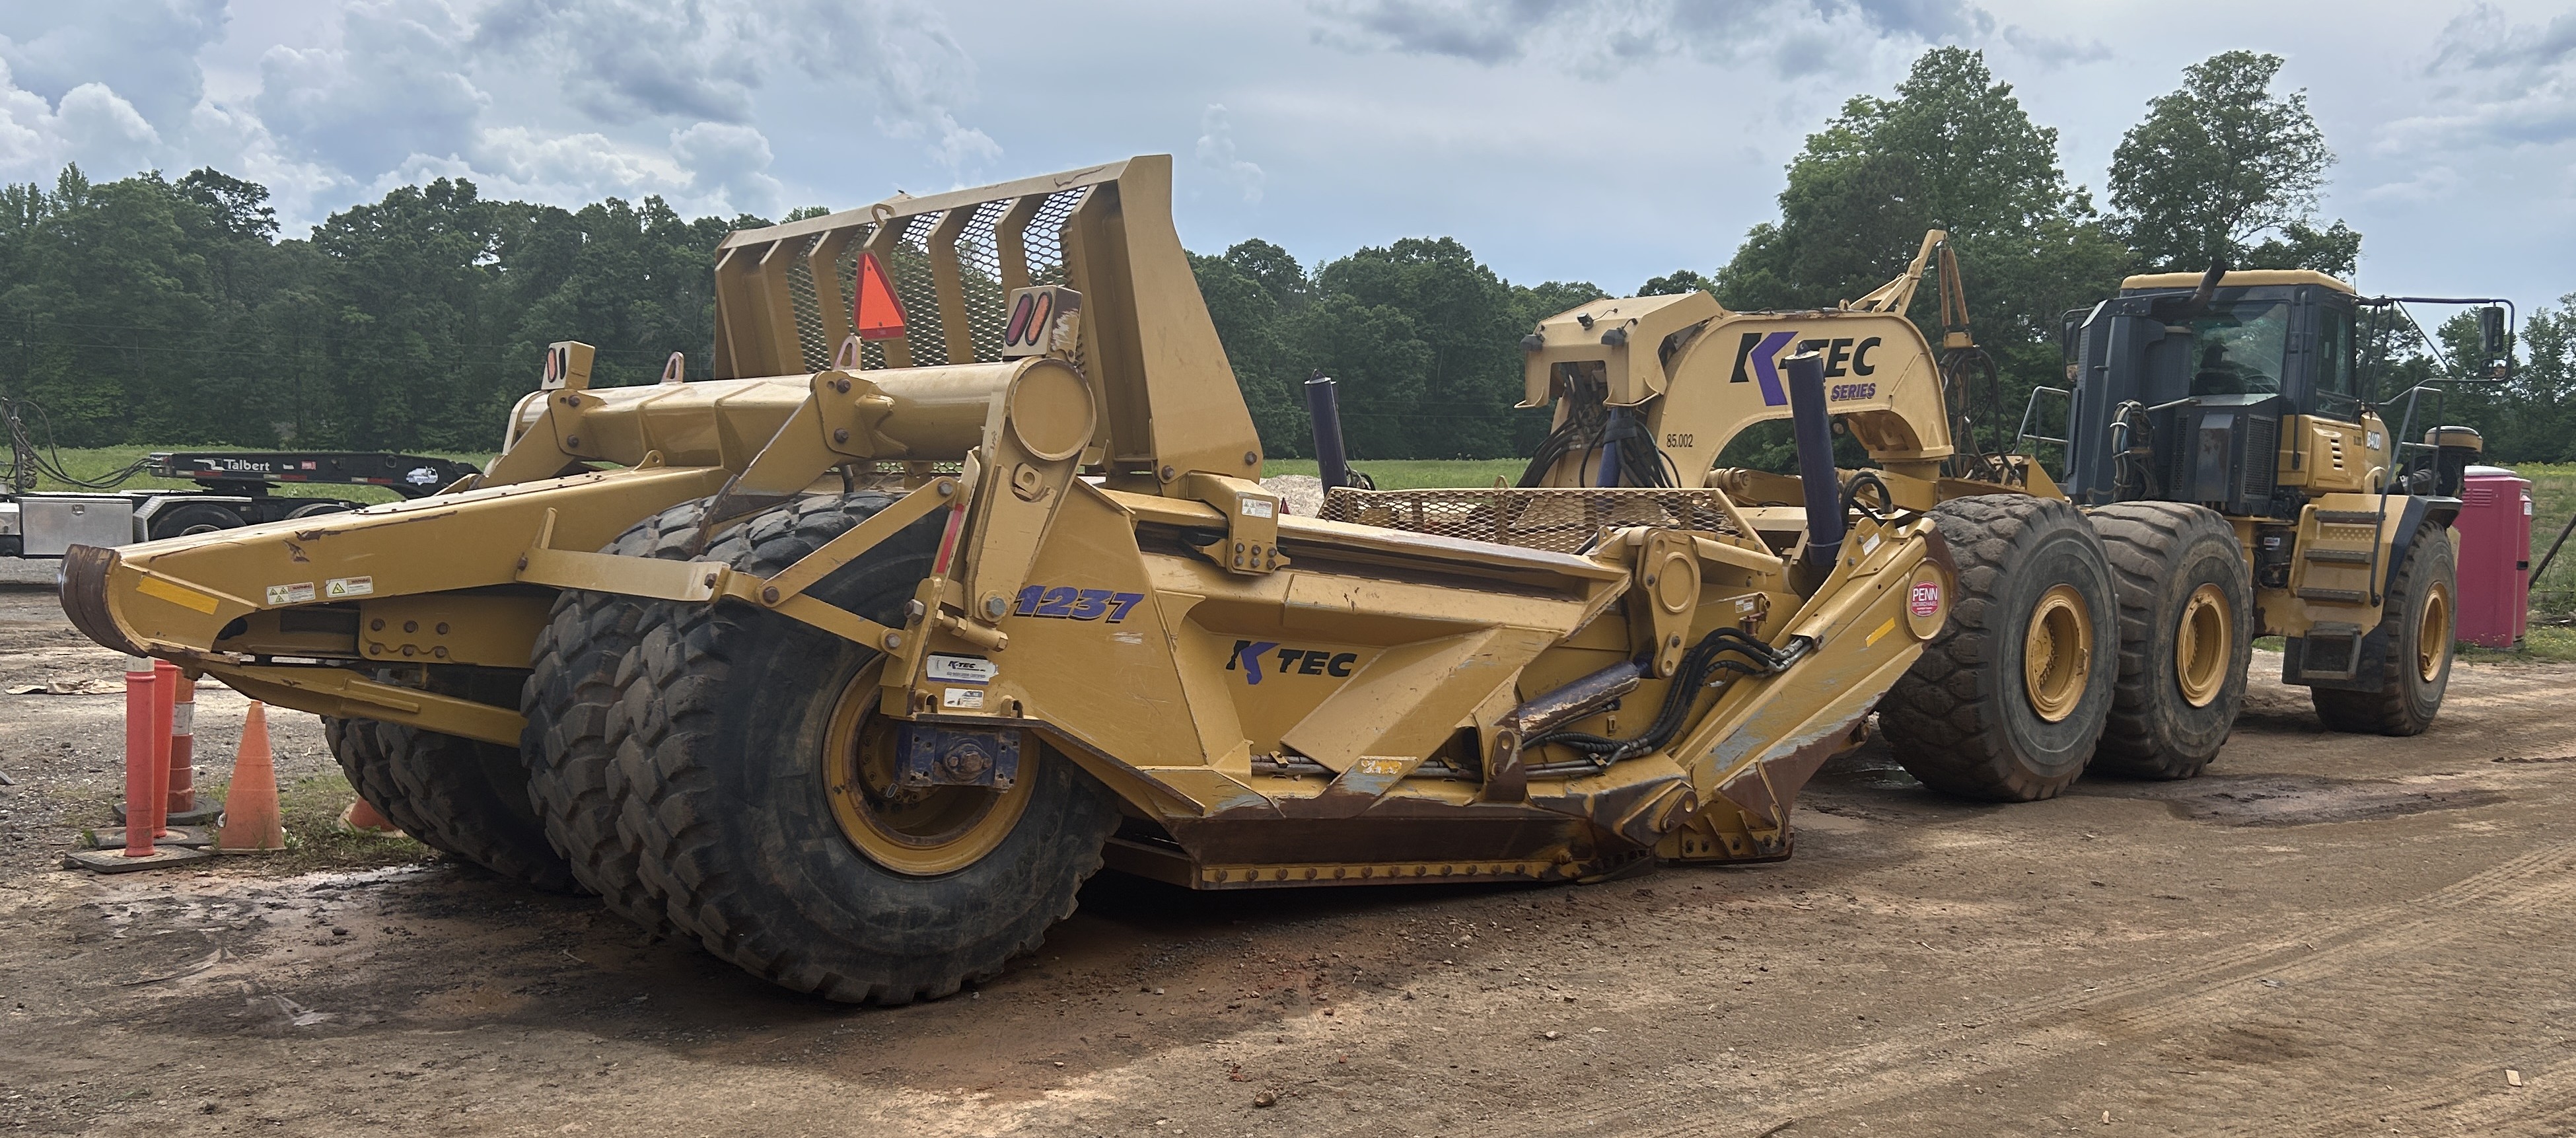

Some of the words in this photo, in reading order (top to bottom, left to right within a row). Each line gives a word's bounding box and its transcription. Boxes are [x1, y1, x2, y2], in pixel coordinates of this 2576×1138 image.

[1730, 331, 1882, 406] K-EC
[1830, 383, 1877, 402] SERIES
[1666, 433, 1693, 447] 85.002
[223, 458, 270, 471] Talbert
[1912, 587, 1938, 601] PENN
[1013, 585, 1145, 624] 1237
[948, 660, 976, 670] K-TEC
